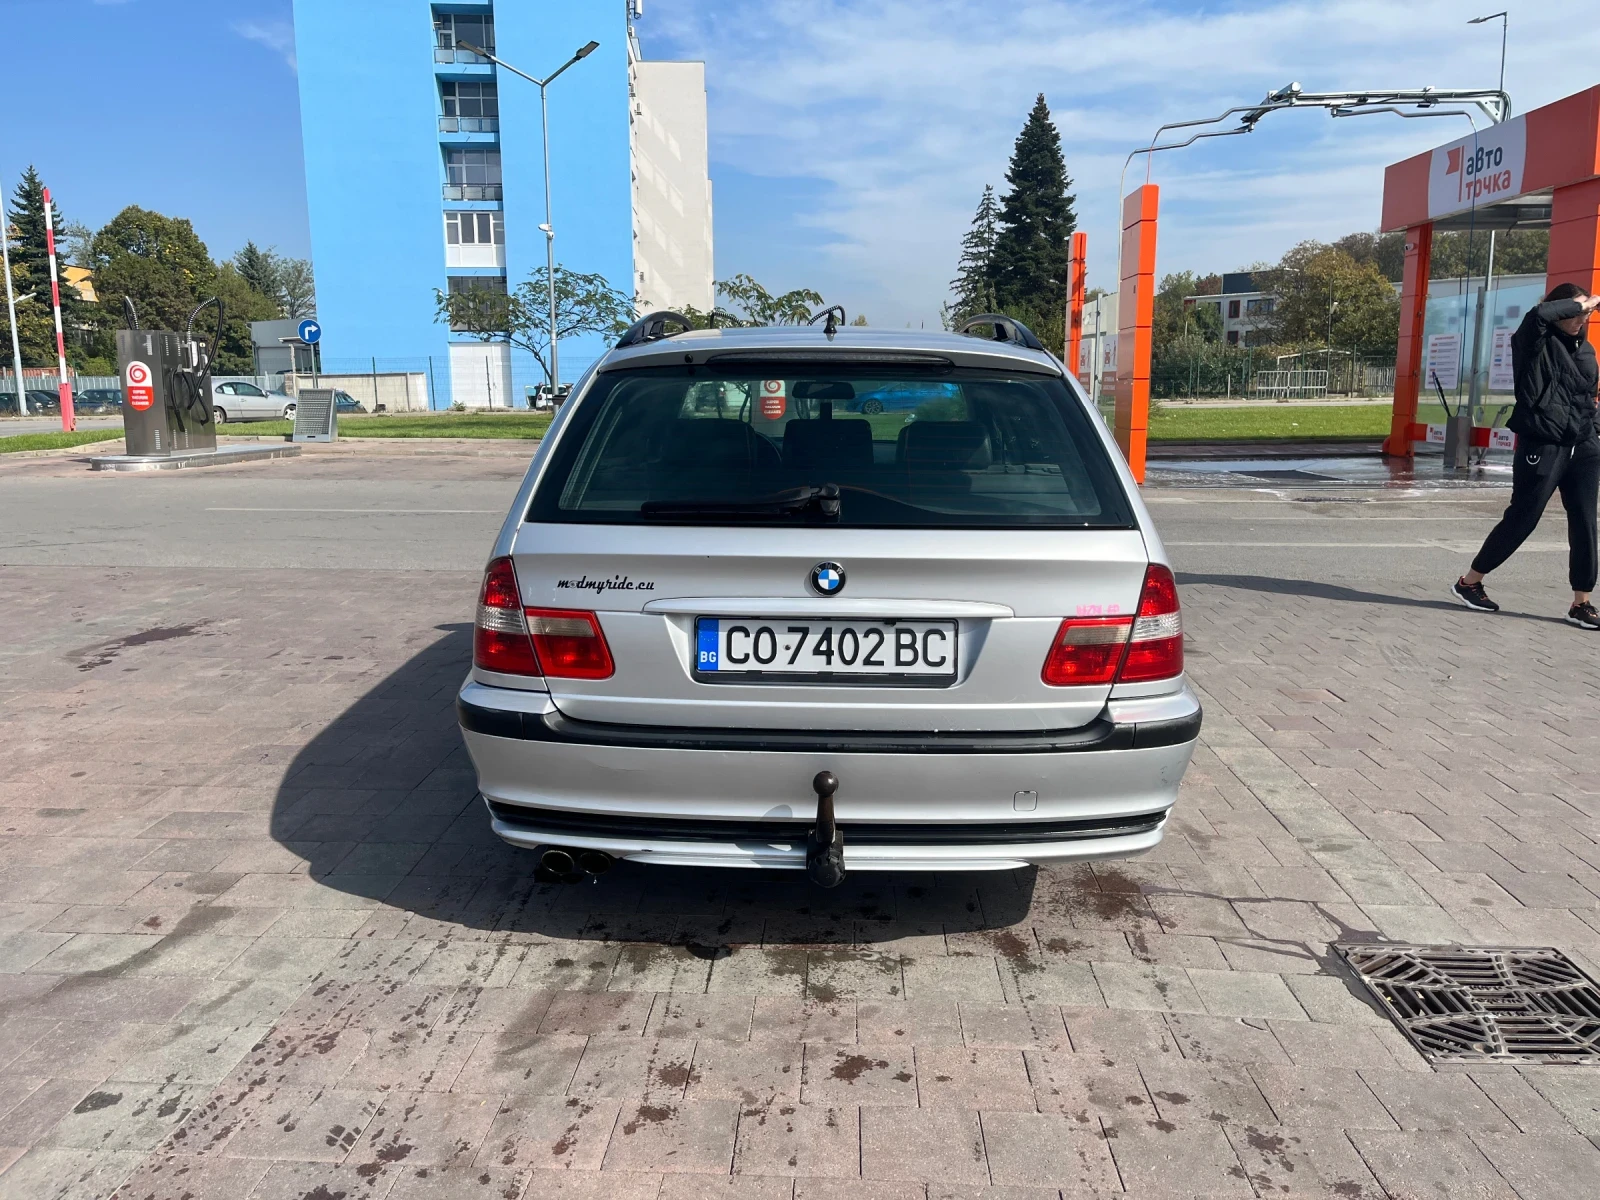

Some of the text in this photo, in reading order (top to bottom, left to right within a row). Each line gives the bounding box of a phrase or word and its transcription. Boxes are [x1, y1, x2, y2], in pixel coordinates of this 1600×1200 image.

[1466, 146, 1503, 175] авто
[1465, 169, 1511, 200] точка
[700, 651, 717, 663] BG
